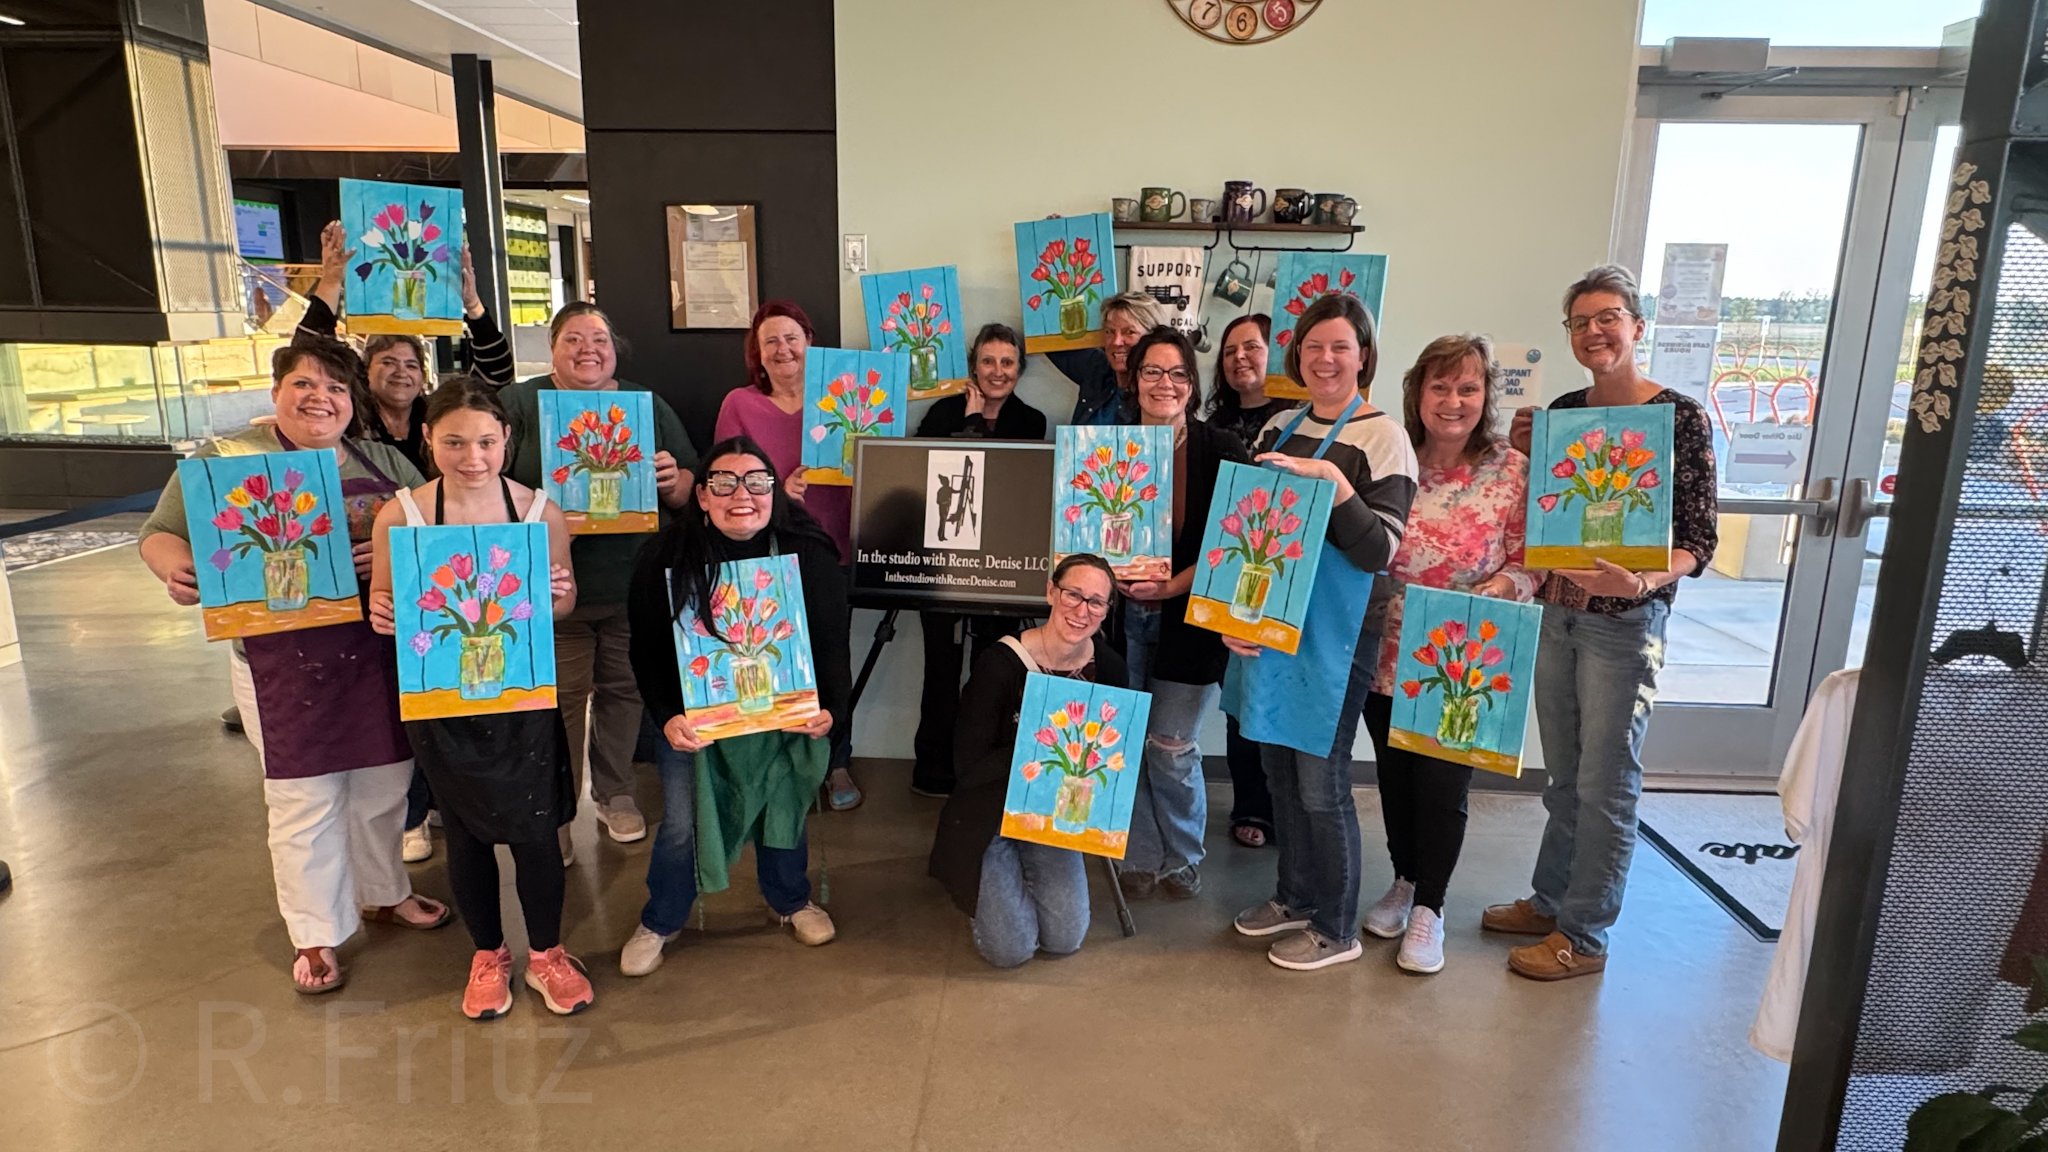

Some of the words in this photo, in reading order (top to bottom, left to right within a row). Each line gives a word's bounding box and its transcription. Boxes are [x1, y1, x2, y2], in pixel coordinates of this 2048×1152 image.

[1202, 2, 1216, 20] 7
[1272, 2, 1288, 22] 5
[1236, 12, 1248, 32] 6
[1137, 262, 1202, 278] SUPPORT
[1170, 317, 1194, 327] OCAL
[1505, 387, 1525, 396] MAX
[857, 549, 869, 563] In
[871, 549, 887, 564] the
[889, 551, 920, 565] studio
[922, 552, 946, 566] with
[985, 554, 1022, 570] Denise
[1024, 556, 1049, 571] LLC
[884, 570, 1017, 588] InthestudiowithReneeDenise.com
